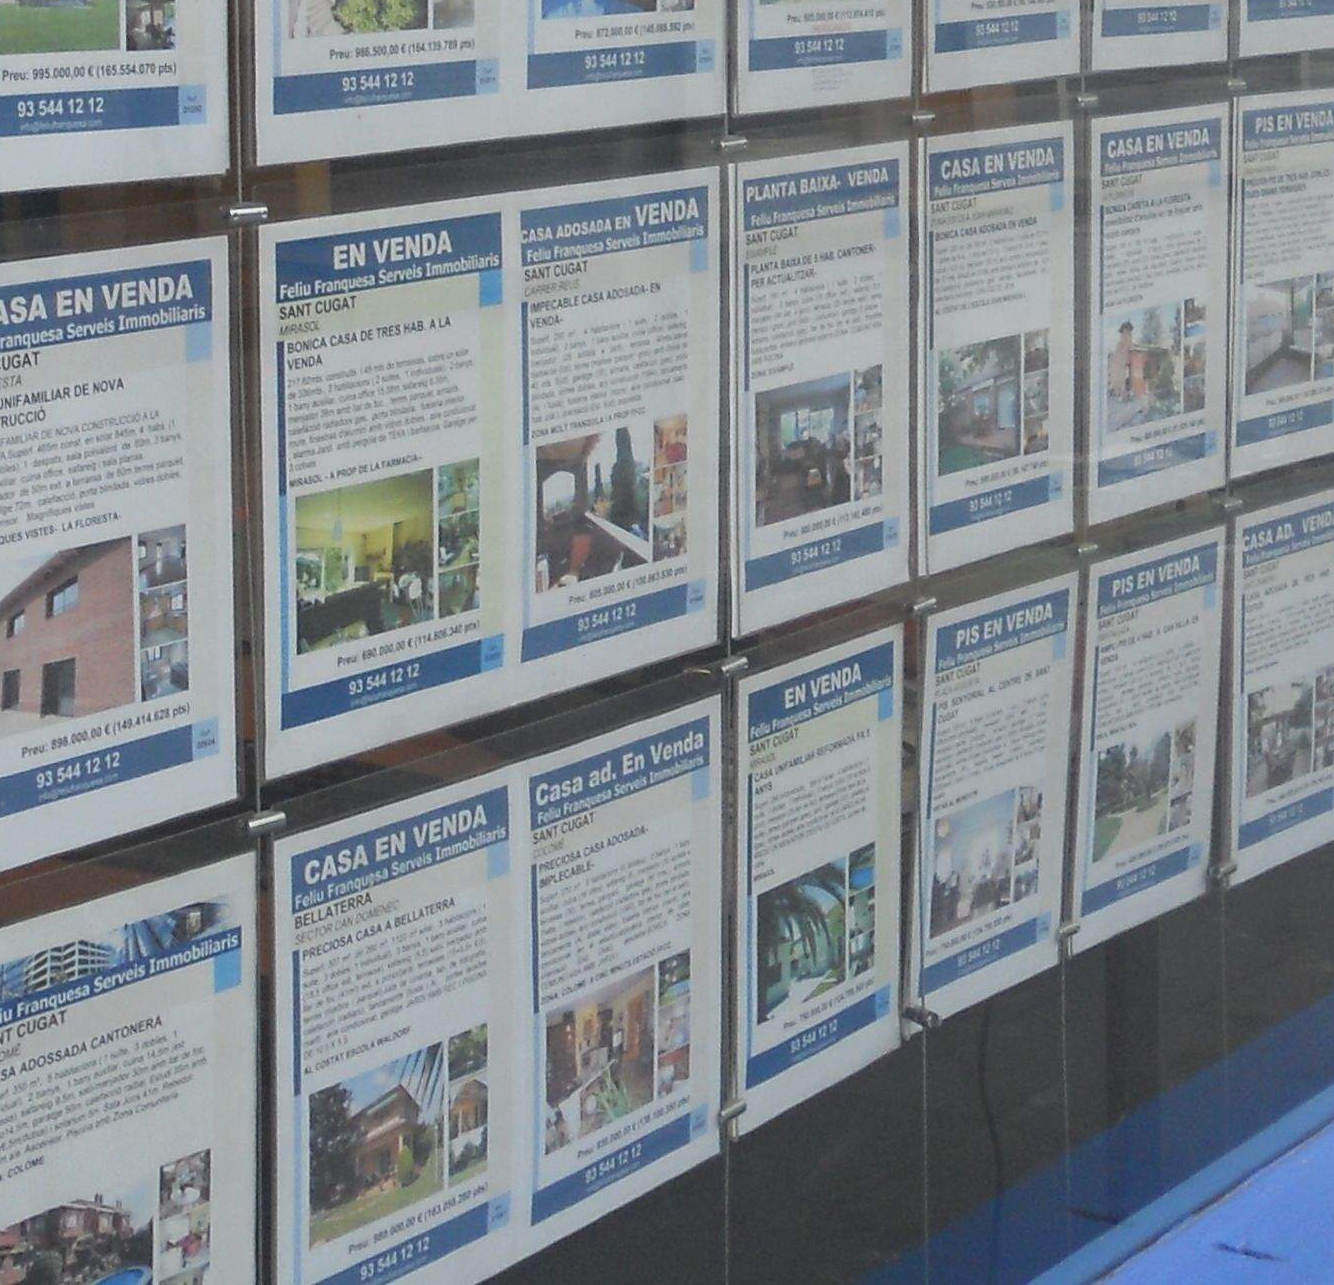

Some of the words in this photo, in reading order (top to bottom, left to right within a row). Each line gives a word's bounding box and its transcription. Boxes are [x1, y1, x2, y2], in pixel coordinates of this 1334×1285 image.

[1108, 135, 1147, 158] CASA
[1149, 133, 1164, 153] EN
[1166, 128, 1209, 151] VENDA
[1255, 115, 1274, 133] PIS
[1277, 114, 1293, 131] EN
[1296, 110, 1333, 129] VENDA
[746, 178, 797, 203] PLANTA
[848, 168, 888, 189] VENDA
[941, 156, 980, 180] CASA
[985, 153, 1004, 175] EN
[1009, 148, 1054, 172] VENDA
[522, 226, 552, 244] CASA
[556, 217, 611, 239] ADOSADA
[615, 215, 631, 231] EN
[635, 197, 699, 226] VENDA
[334, 241, 365, 270] EN
[373, 230, 453, 264] VENDA
[57, 287, 92, 317] EN
[101, 273, 193, 311] VENDA
[1113, 572, 1133, 597] PIS
[1137, 567, 1154, 591] EN
[1158, 557, 1200, 586] VENDA
[956, 623, 980, 649] PIS
[984, 617, 1003, 641] EN
[1007, 603, 1053, 634] VENDA
[784, 680, 806, 709] EN
[808, 663, 862, 701] VENDA
[535, 768, 583, 806] Casa
[590, 758, 616, 788] ad.
[622, 749, 645, 778] En
[651, 730, 704, 768] Venda
[305, 842, 367, 885] CASA
[375, 830, 405, 862] EN
[413, 805, 486, 849] VENDA
[294, 893, 372, 929] BELLATERRA
[17, 983, 90, 1019] Franquesa
[93, 963, 145, 994] Serveis
[150, 934, 239, 974] Immobiliaris
[20, 1040, 87, 1074] ADOSSADA
[92, 1015, 162, 1051] CANTONERA
